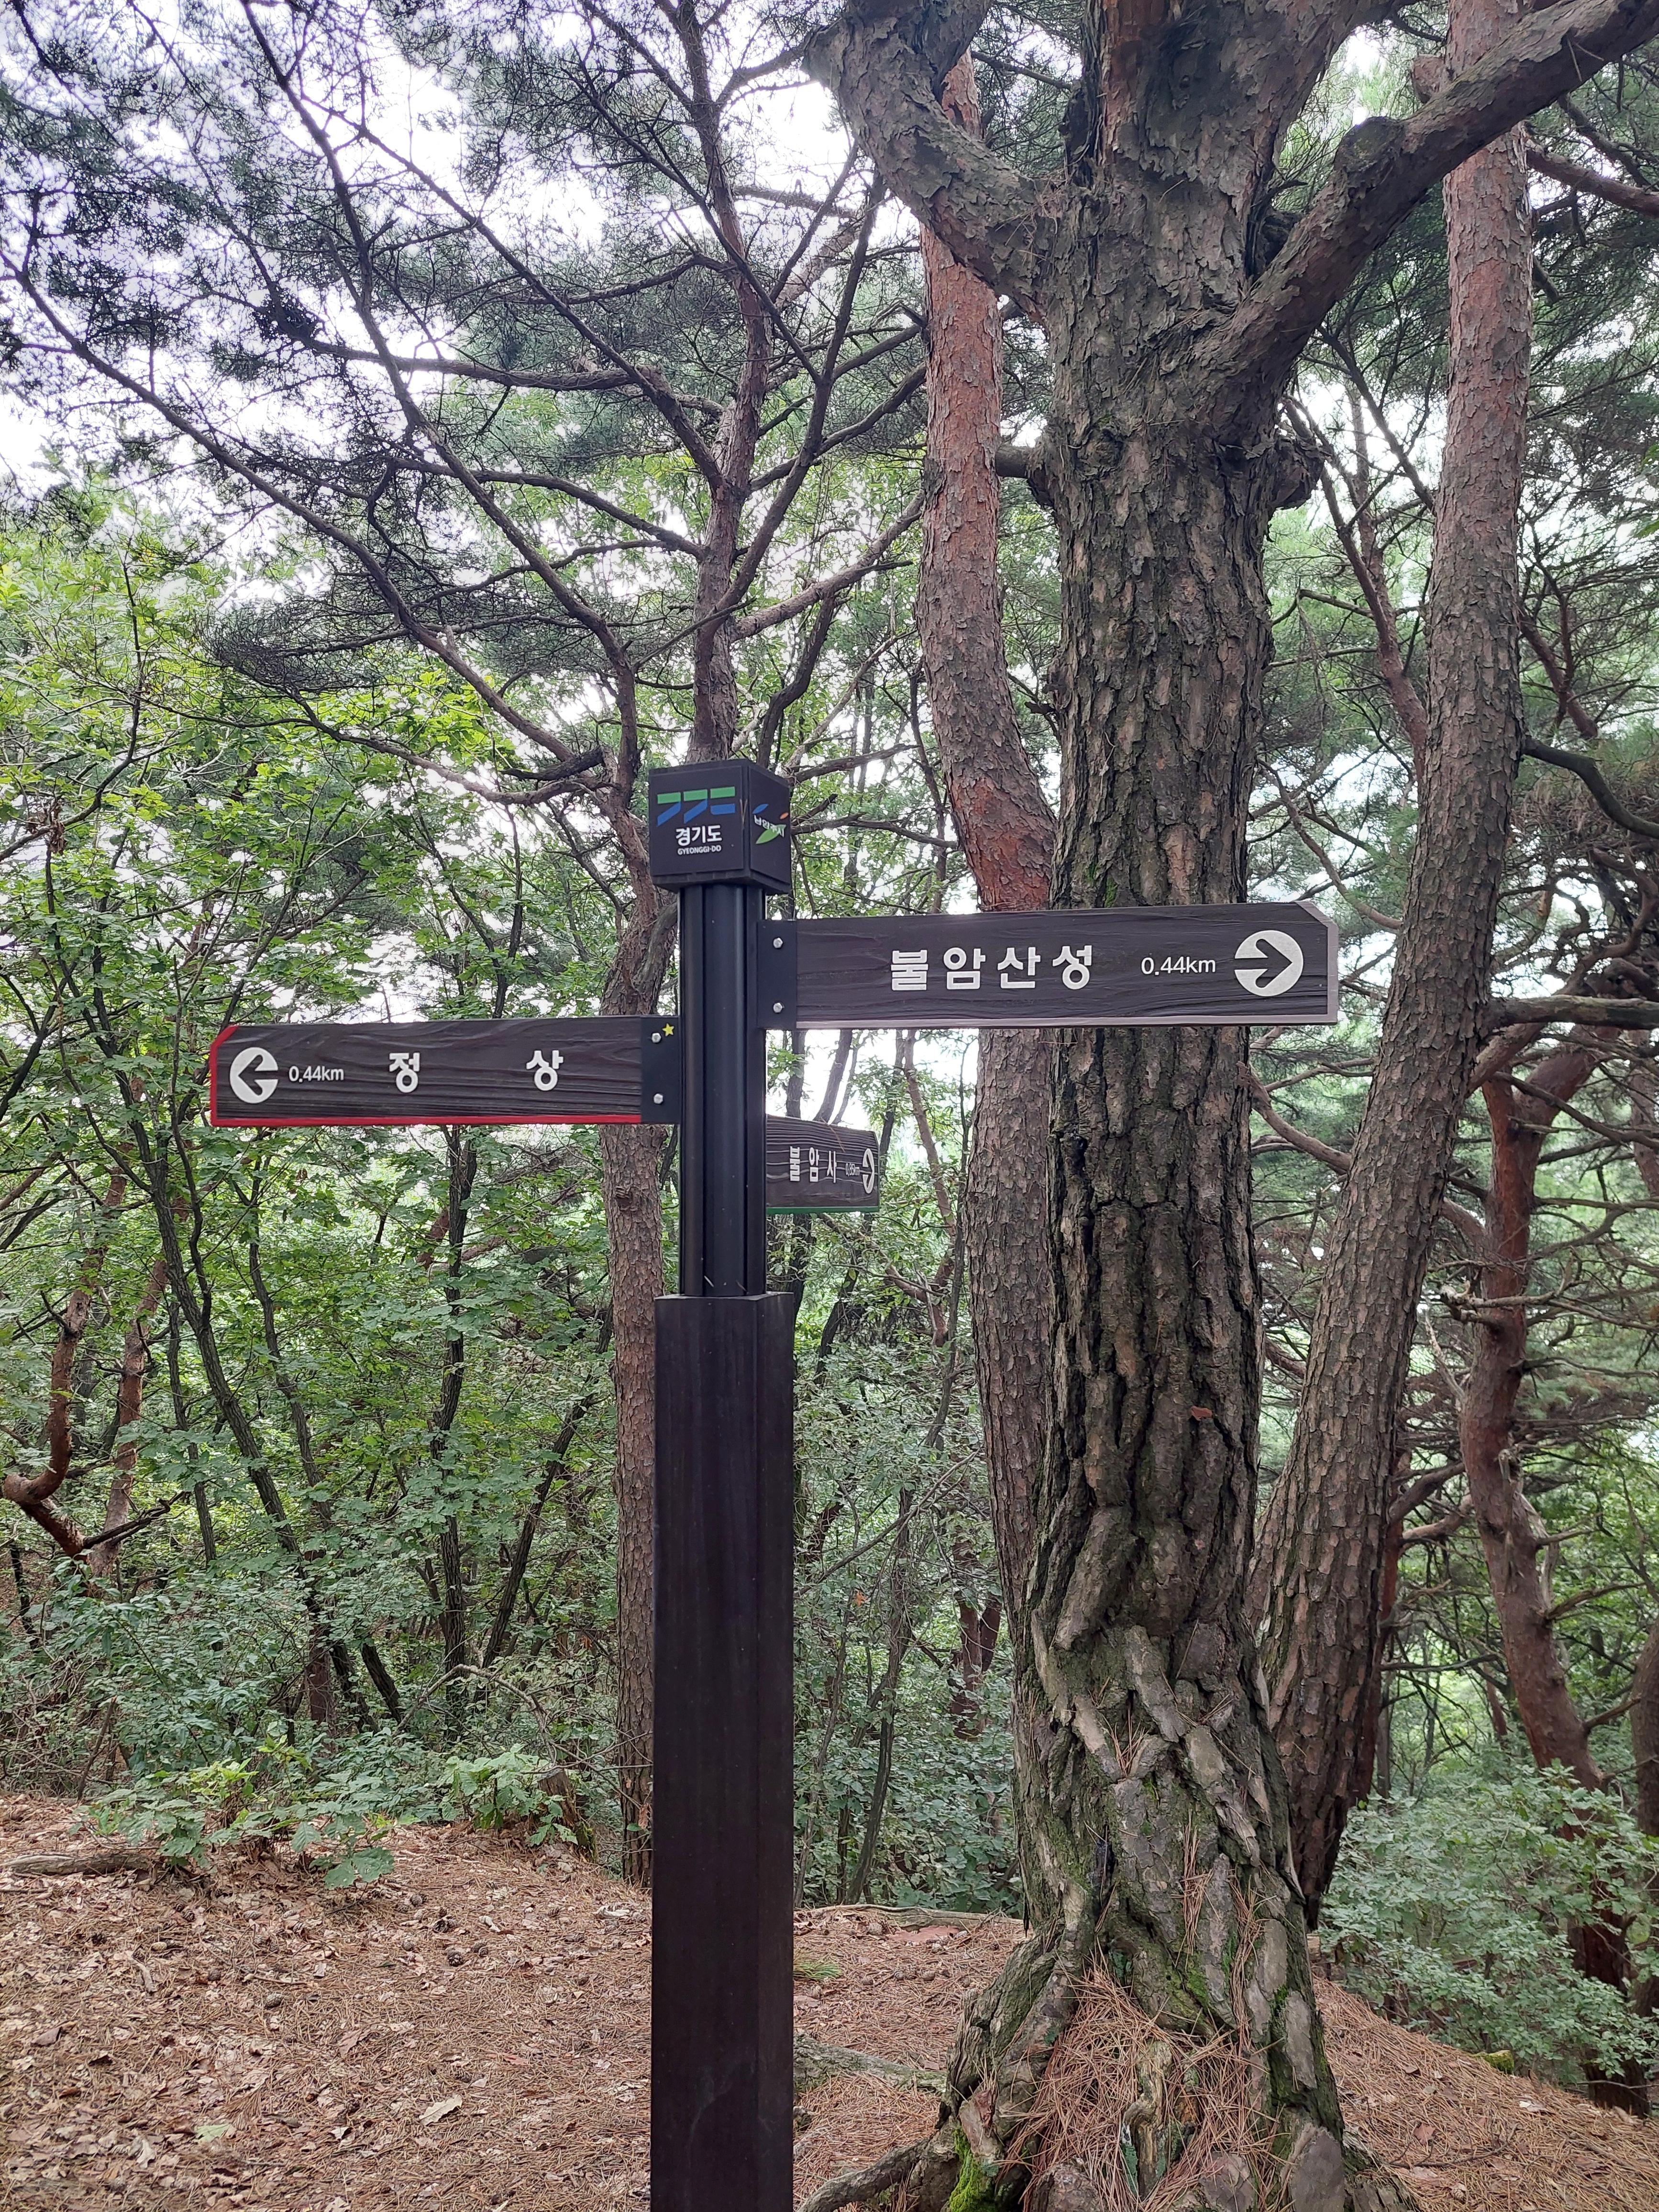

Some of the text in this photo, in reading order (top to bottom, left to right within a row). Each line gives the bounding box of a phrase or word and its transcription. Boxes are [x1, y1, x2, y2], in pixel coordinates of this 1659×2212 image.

[675, 825, 722, 846] 경기도
[891, 945, 1216, 991] 불암산성 0.44km
[289, 1050, 564, 1094] 0.44km 정상
[790, 1146, 837, 1183] 불암사
